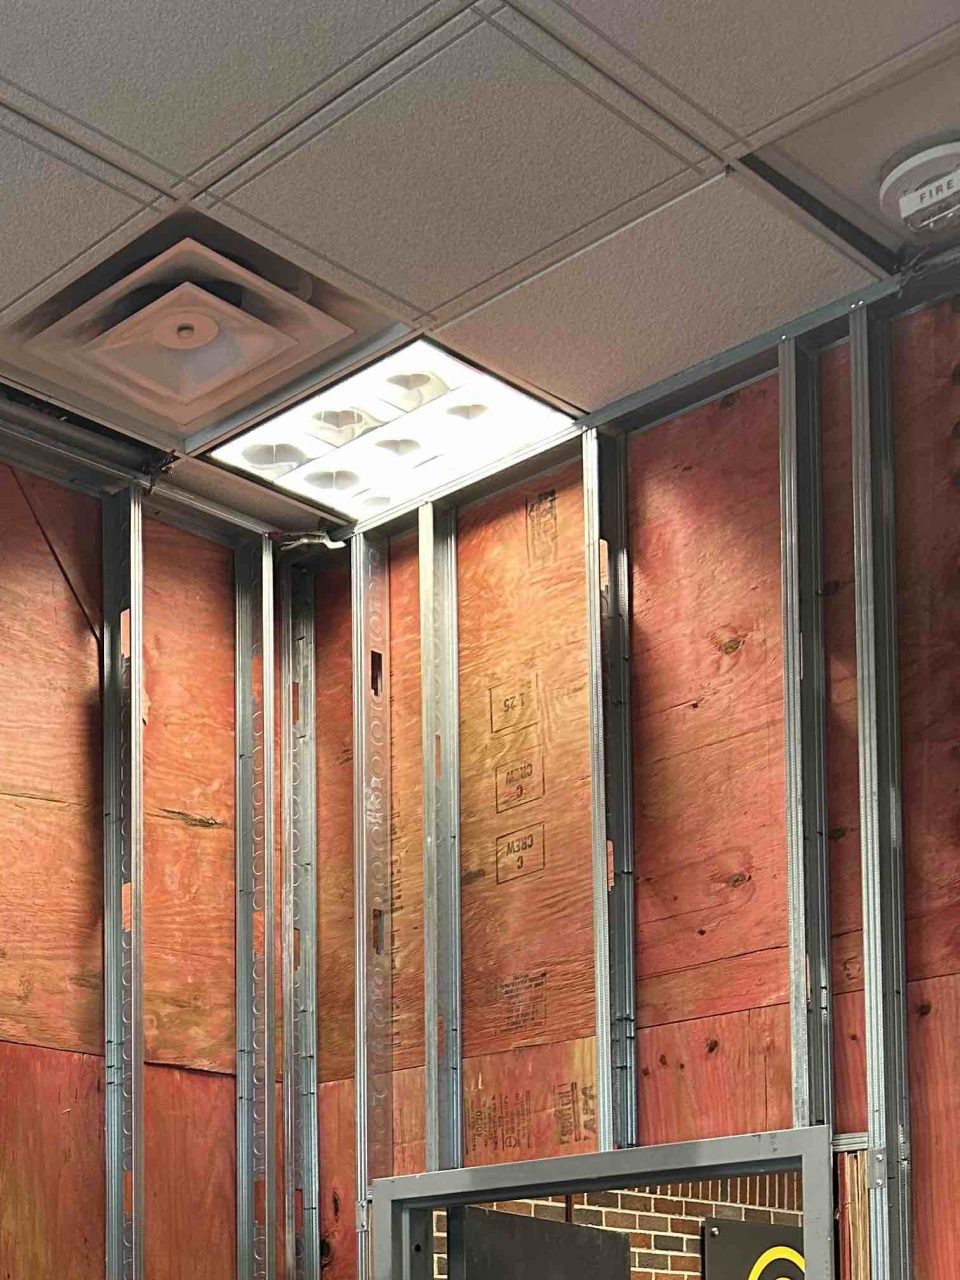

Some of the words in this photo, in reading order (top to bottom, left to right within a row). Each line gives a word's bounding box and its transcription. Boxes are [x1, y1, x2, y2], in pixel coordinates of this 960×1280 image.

[920, 178, 955, 203] FIRE
[505, 834, 534, 857] CREW
[516, 855, 524, 870] C
